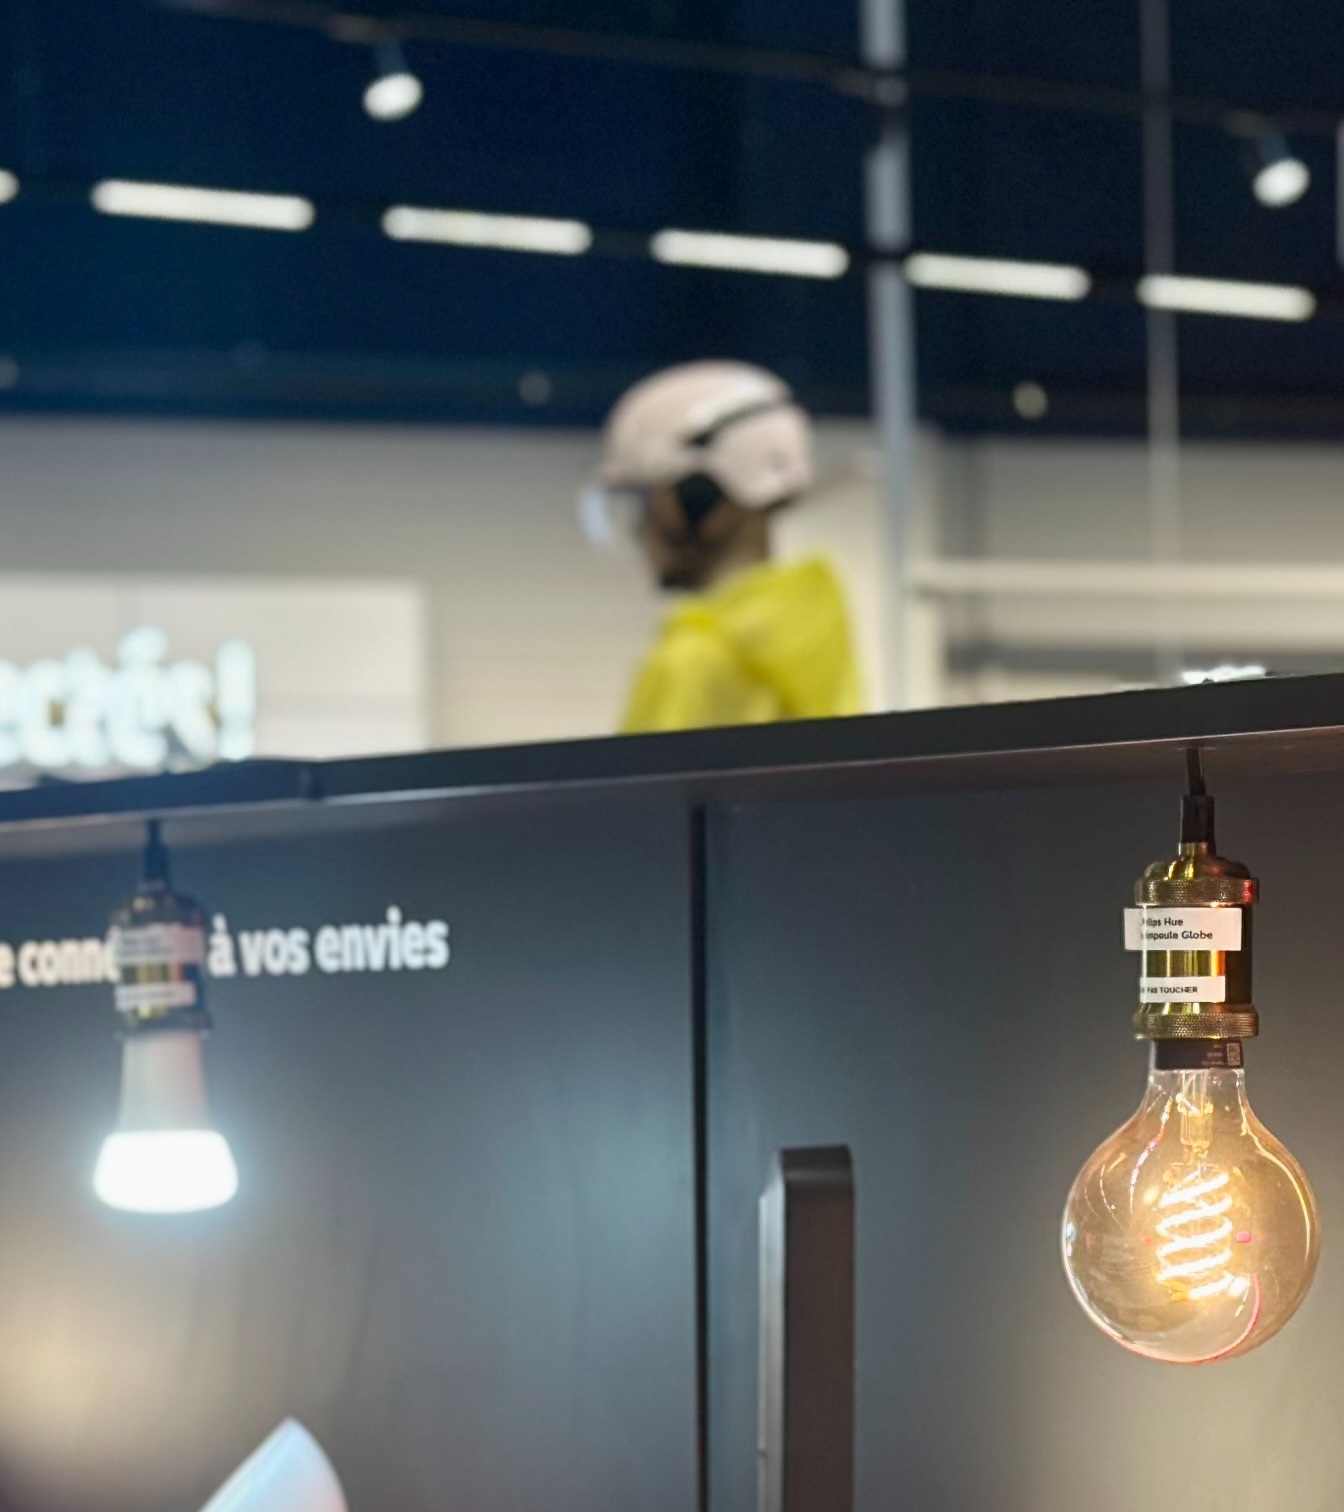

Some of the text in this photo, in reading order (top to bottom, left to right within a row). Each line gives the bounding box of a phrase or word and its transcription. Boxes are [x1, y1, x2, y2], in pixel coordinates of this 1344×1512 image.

[1164, 916, 1184, 927] Hue
[1181, 930, 1214, 940] Globe
[208, 913, 236, 977] à
[238, 927, 311, 977] vos
[315, 905, 450, 973] envies
[1159, 986, 1198, 994] TOUCHER
